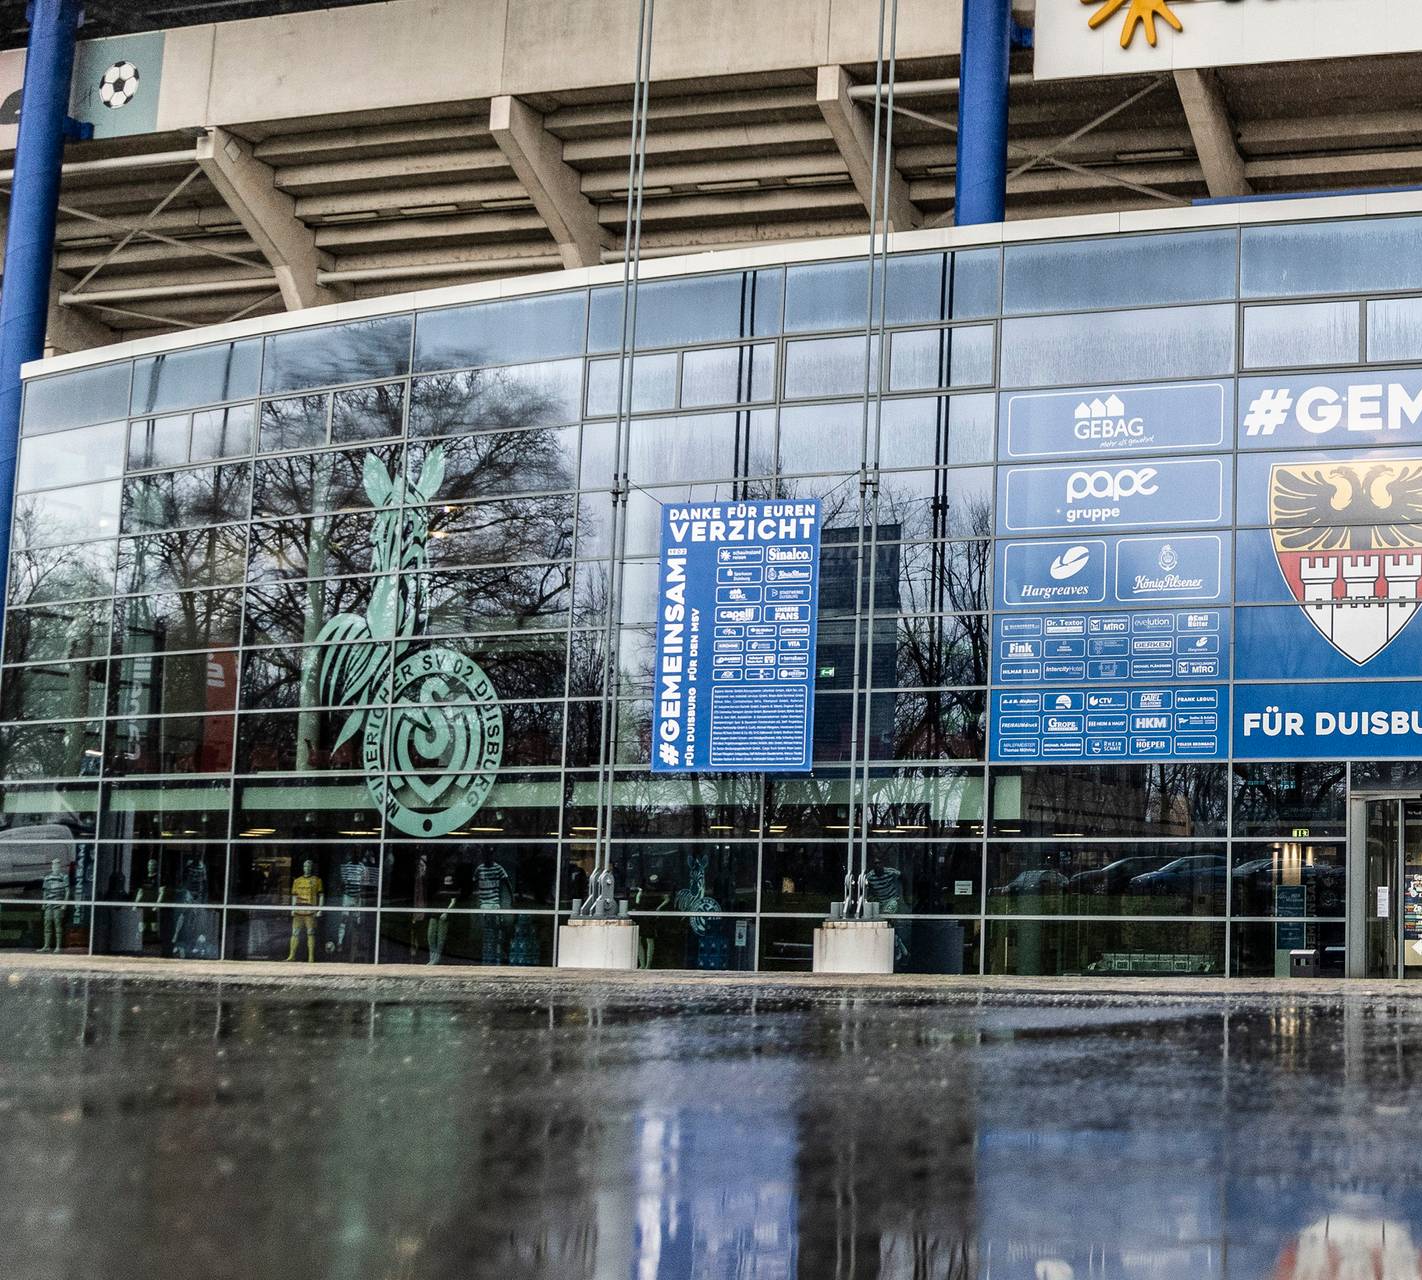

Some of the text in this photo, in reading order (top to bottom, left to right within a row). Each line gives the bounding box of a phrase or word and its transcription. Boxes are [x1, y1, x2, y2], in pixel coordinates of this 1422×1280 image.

[1074, 417, 1144, 440] GEBAG
[1066, 467, 1159, 504] pape
[669, 503, 815, 521] DANKE FÜR EUREN
[1067, 507, 1120, 522] gruppe
[669, 518, 815, 543] VERZICHT
[1021, 584, 1089, 599] Hargreaves
[775, 612, 799, 620] FANS
[1010, 643, 1032, 653] Fink
[423, 654, 446, 671] SV
[453, 659, 475, 682] 02
[659, 558, 687, 766] #GEMEINSAM
[685, 608, 701, 766] FÜR DUISBURG FÜR DEN MSV
[1136, 718, 1167, 728] HKM
[1244, 706, 1305, 736] FÜR
